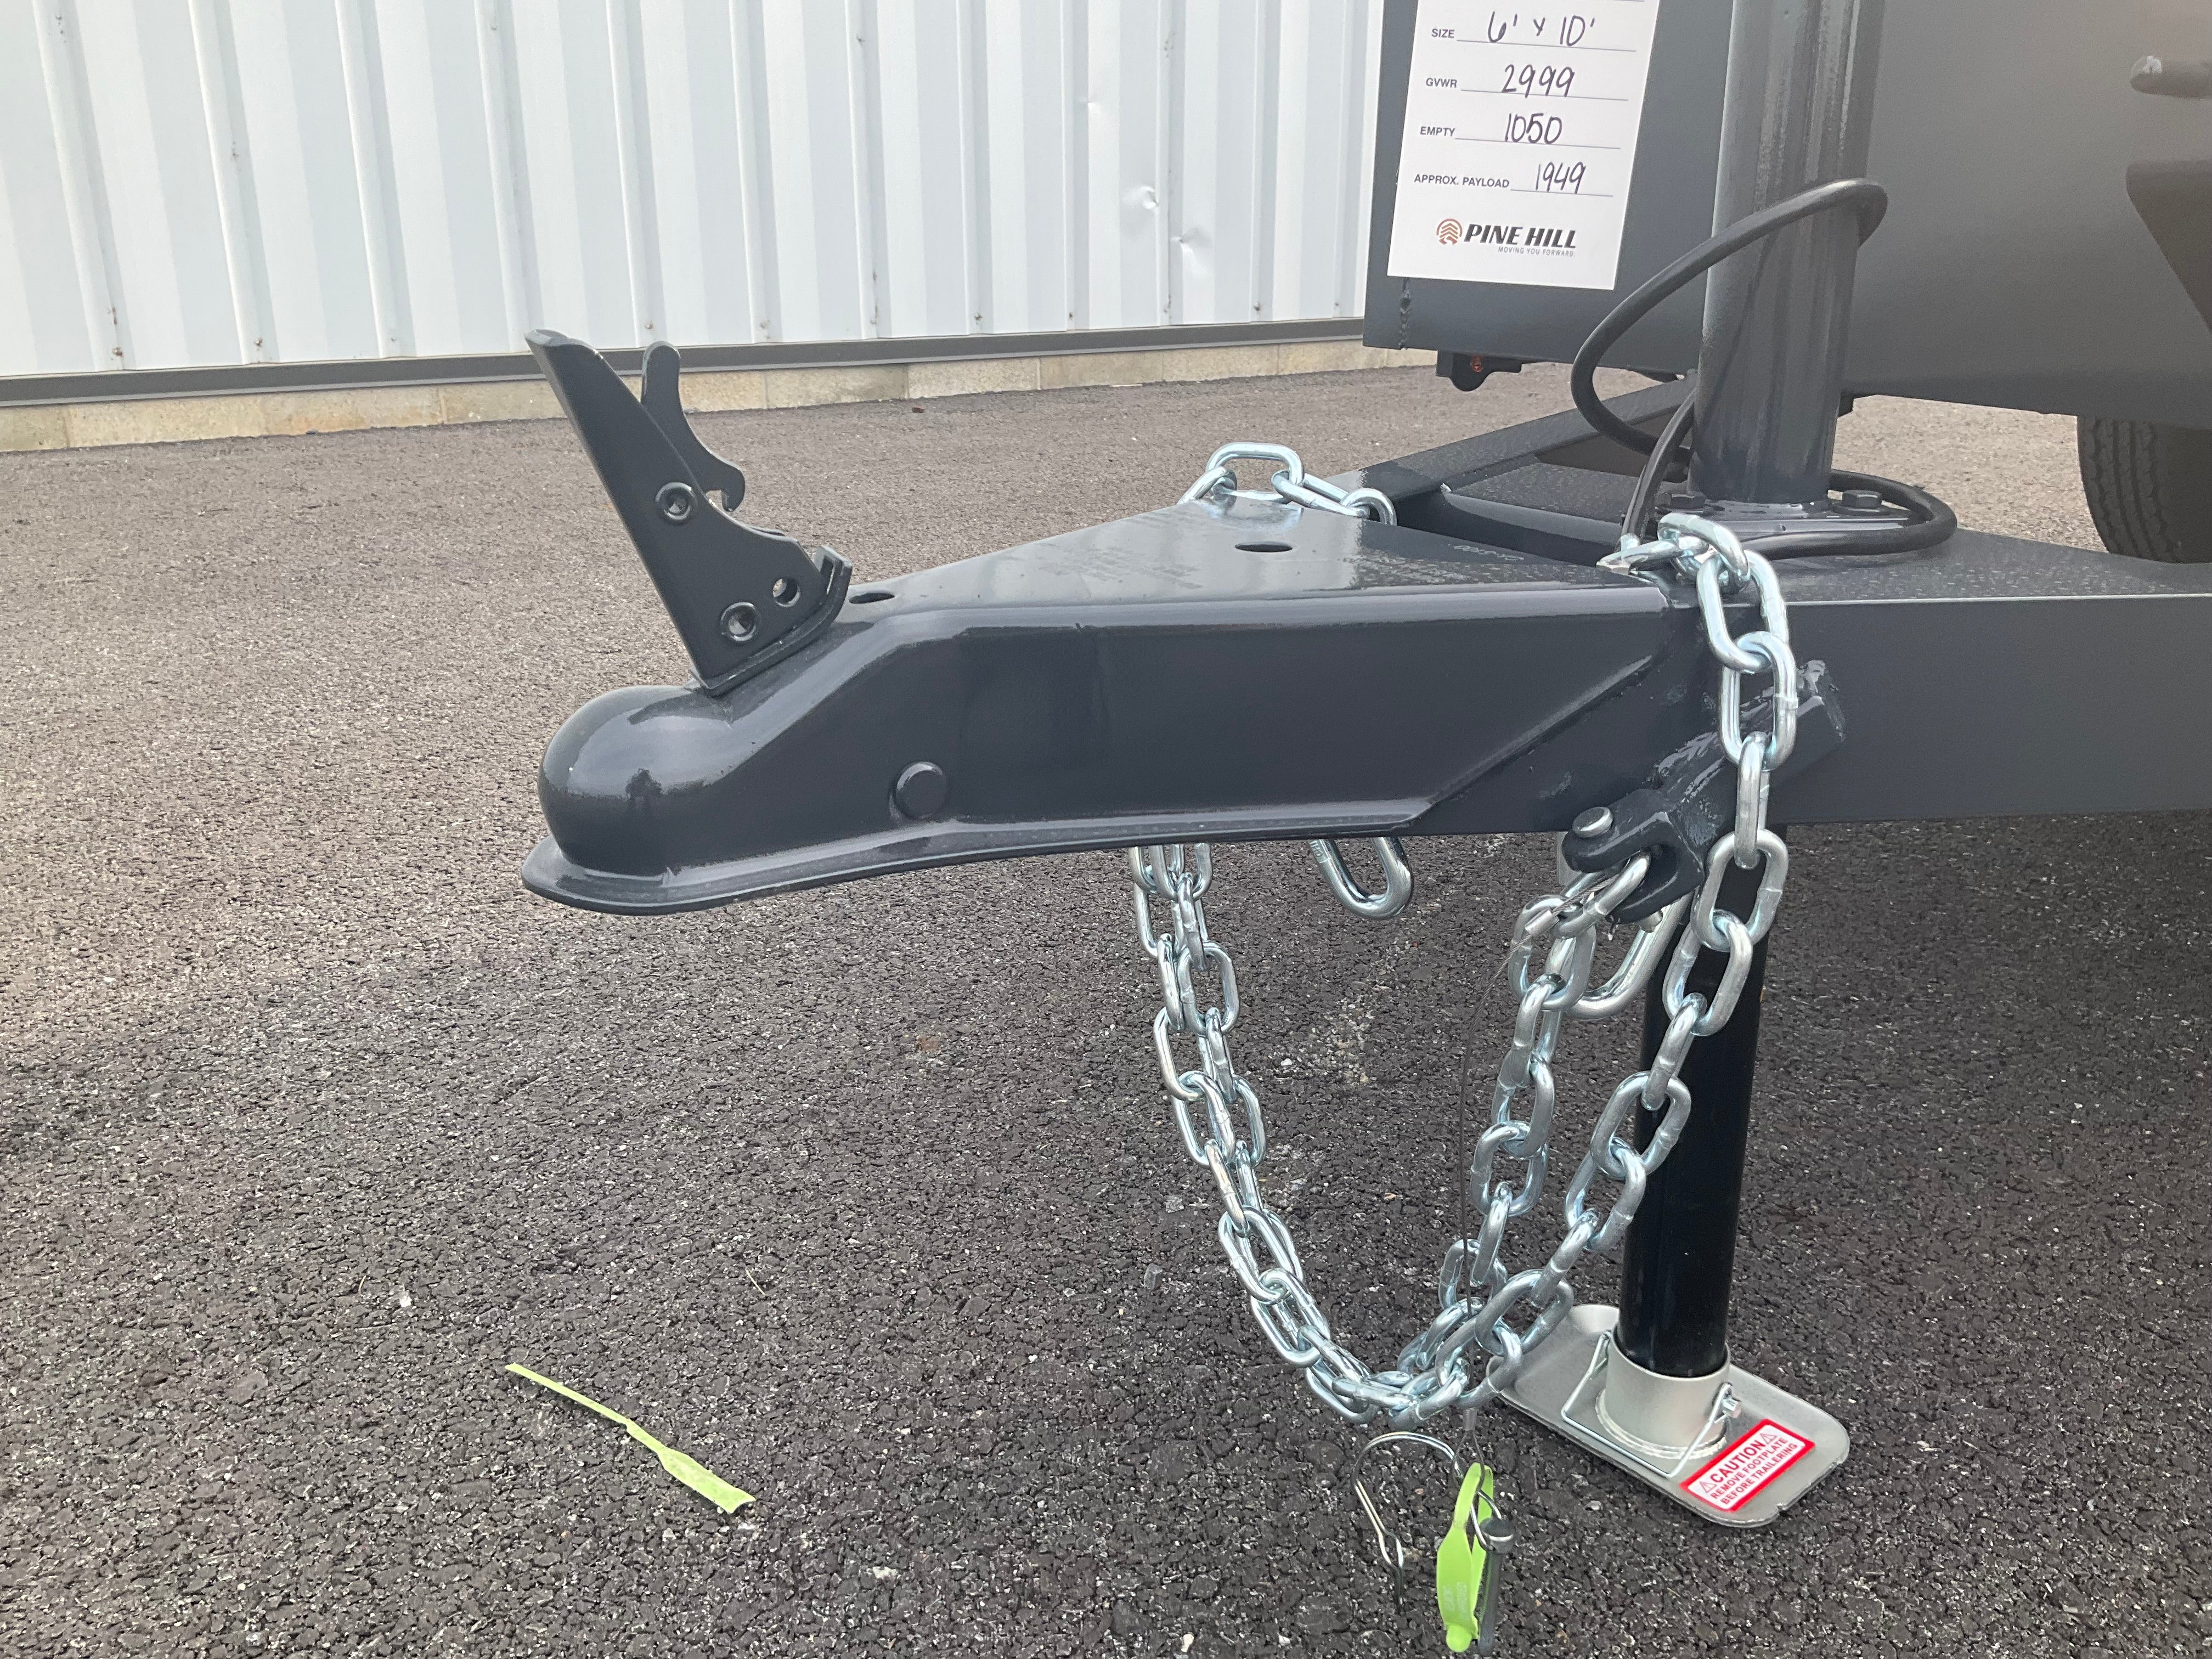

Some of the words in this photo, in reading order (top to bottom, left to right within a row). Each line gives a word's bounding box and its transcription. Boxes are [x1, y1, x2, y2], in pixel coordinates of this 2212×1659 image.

[1431, 28, 1455, 39] SIZE
[1487, 11, 1518, 43] 6'
[1560, 15, 1595, 47] 10'
[1425, 77, 1457, 89] GVWR
[1500, 64, 1575, 99] 2999
[1420, 126, 1455, 137] EMPTY
[1504, 112, 1562, 145] 1050
[1414, 174, 1459, 185] APPROX.
[1462, 177, 1510, 189] PAYLOAD
[1535, 161, 1586, 194] 1949
[1464, 223, 1523, 245] PINE
[1524, 227, 1577, 249] HILL
[1498, 246, 1524, 255] MOVING
[1542, 249, 1576, 257] FORWARD.
[1710, 1439, 1766, 1483] CAUTION
[1711, 1471, 1746, 1499] REMOVE
[1742, 1437, 1788, 1473] FOOTPLATE
[1720, 1478, 1755, 1504] BEFORE
[1752, 1443, 1798, 1480] TRAILERING
